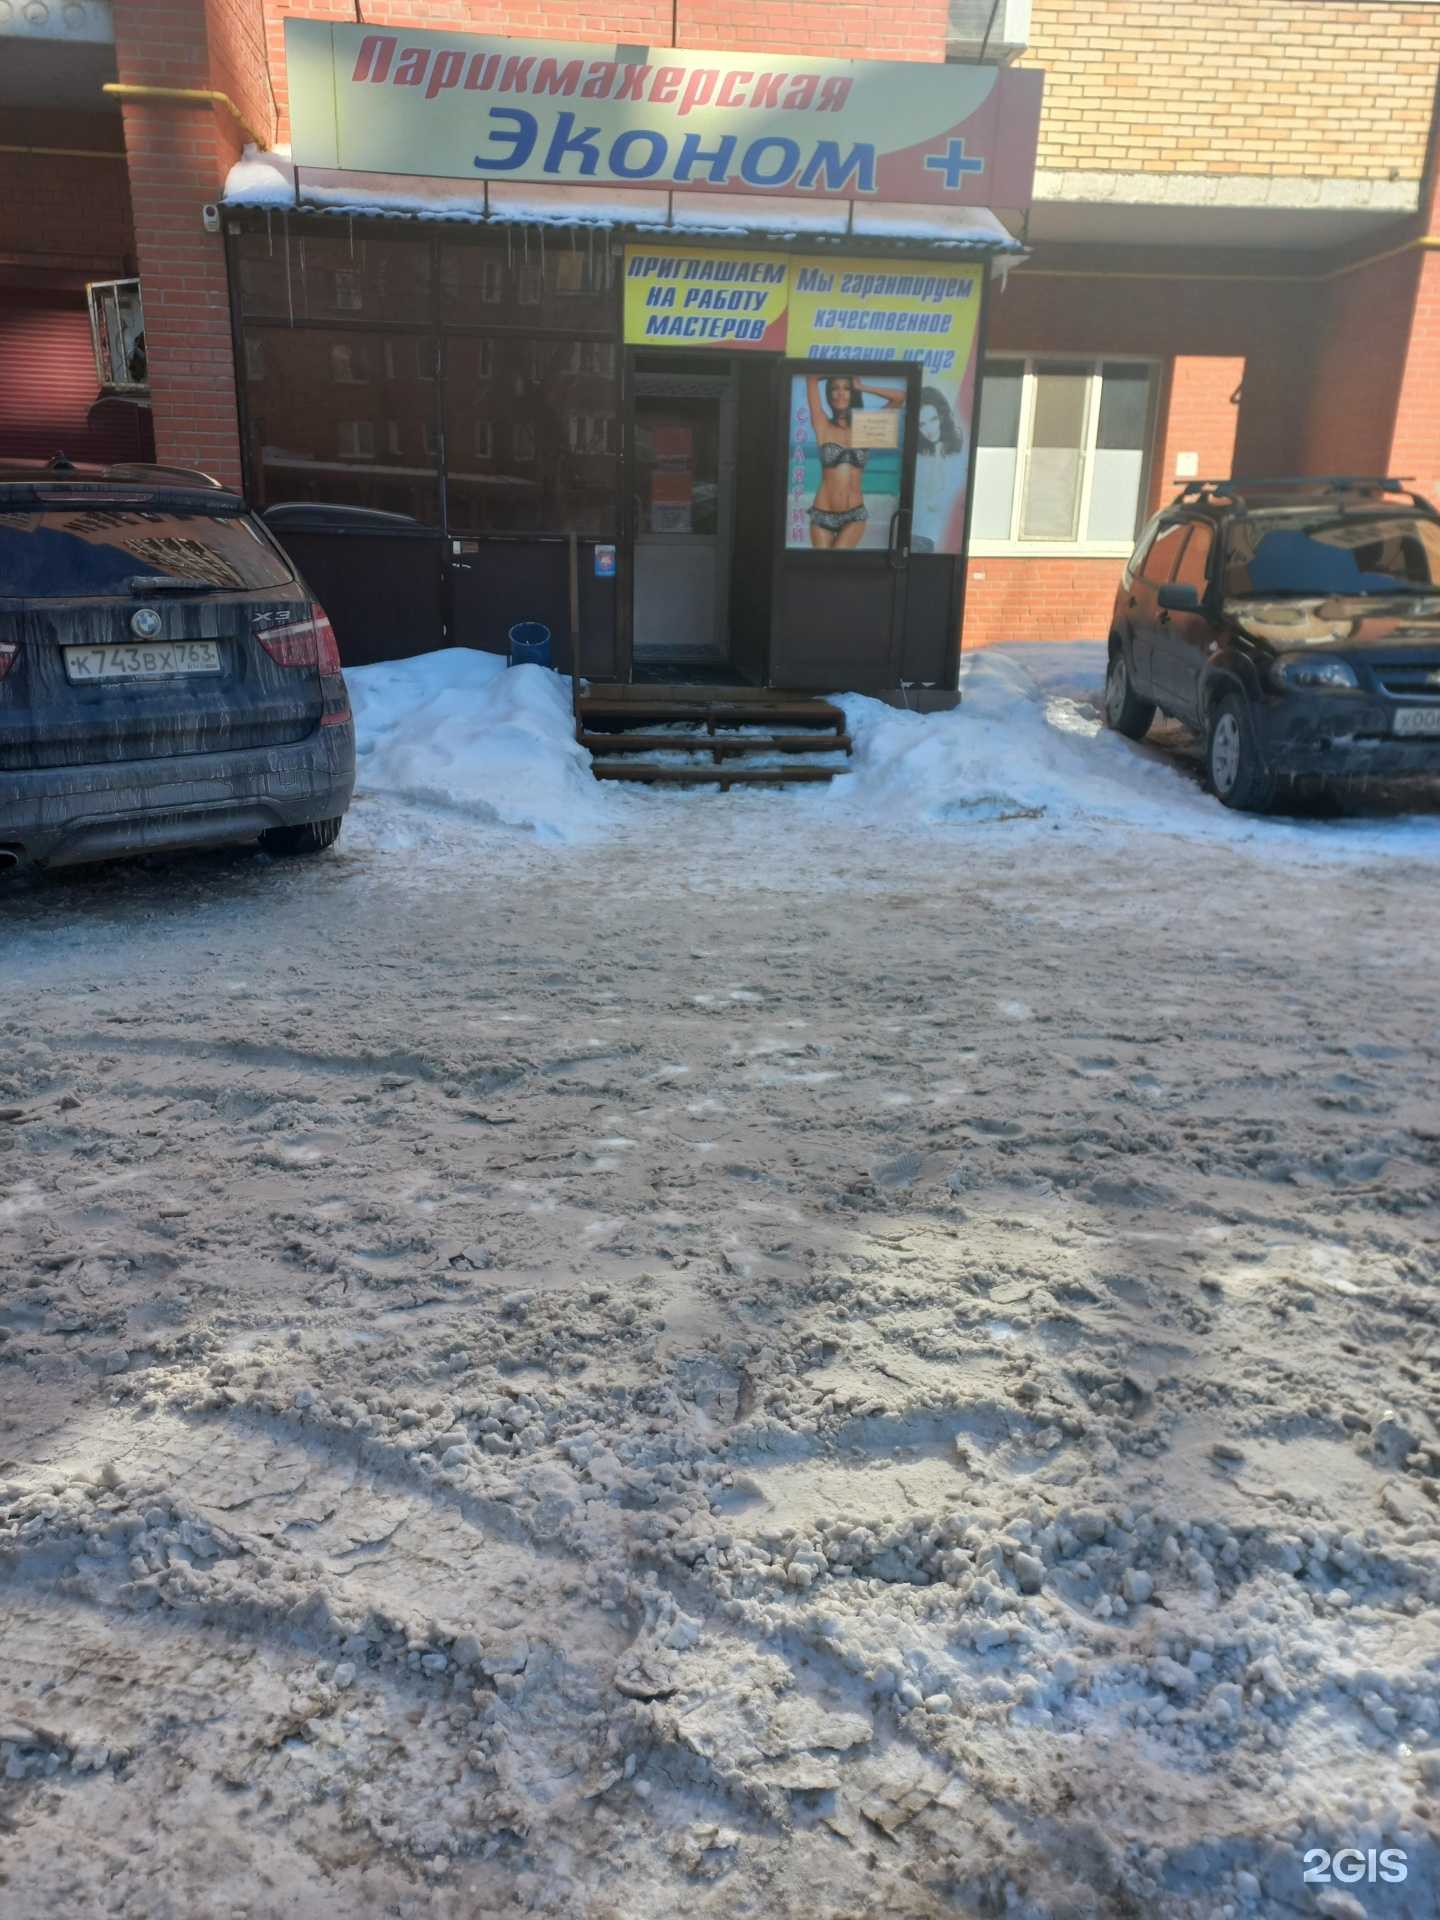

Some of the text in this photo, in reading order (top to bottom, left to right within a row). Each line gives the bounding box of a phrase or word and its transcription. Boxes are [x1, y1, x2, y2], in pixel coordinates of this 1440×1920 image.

[352, 35, 854, 116] Парикмахерская
[628, 256, 787, 284] ПРИГЛАШАЕМ
[646, 286, 768, 312] НА РАБОТУ
[796, 268, 974, 305] Мы гарантируем
[645, 315, 766, 340] МАСТЕРОВ
[814, 308, 953, 334] качественное
[176, 645, 211, 663] 763
